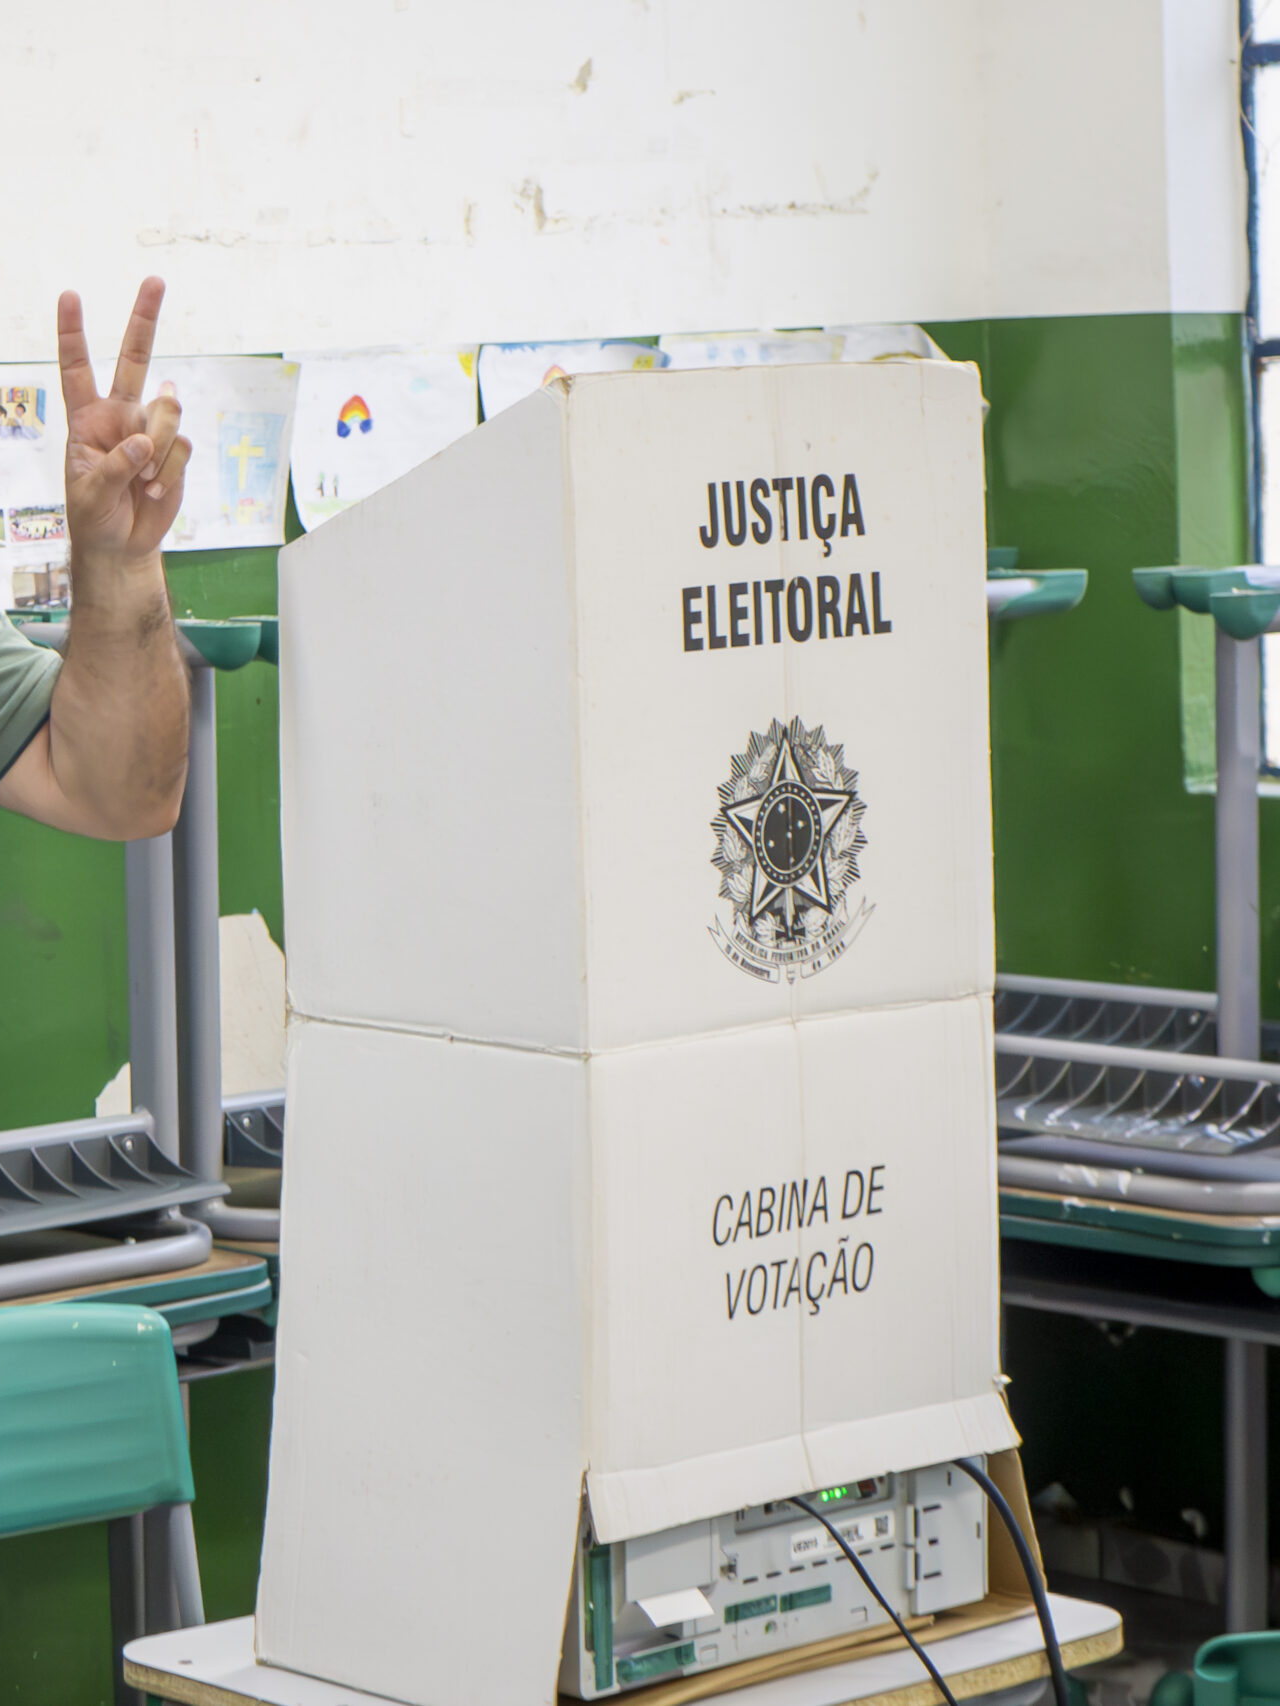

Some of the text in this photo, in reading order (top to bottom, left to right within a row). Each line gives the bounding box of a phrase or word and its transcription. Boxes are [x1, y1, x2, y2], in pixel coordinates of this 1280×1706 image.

[699, 473, 866, 558] JUSTIÇA
[682, 571, 892, 652] ELEITORAL
[713, 1165, 885, 1246] CABINA DE
[726, 1235, 874, 1320] VOTAÇÃO
